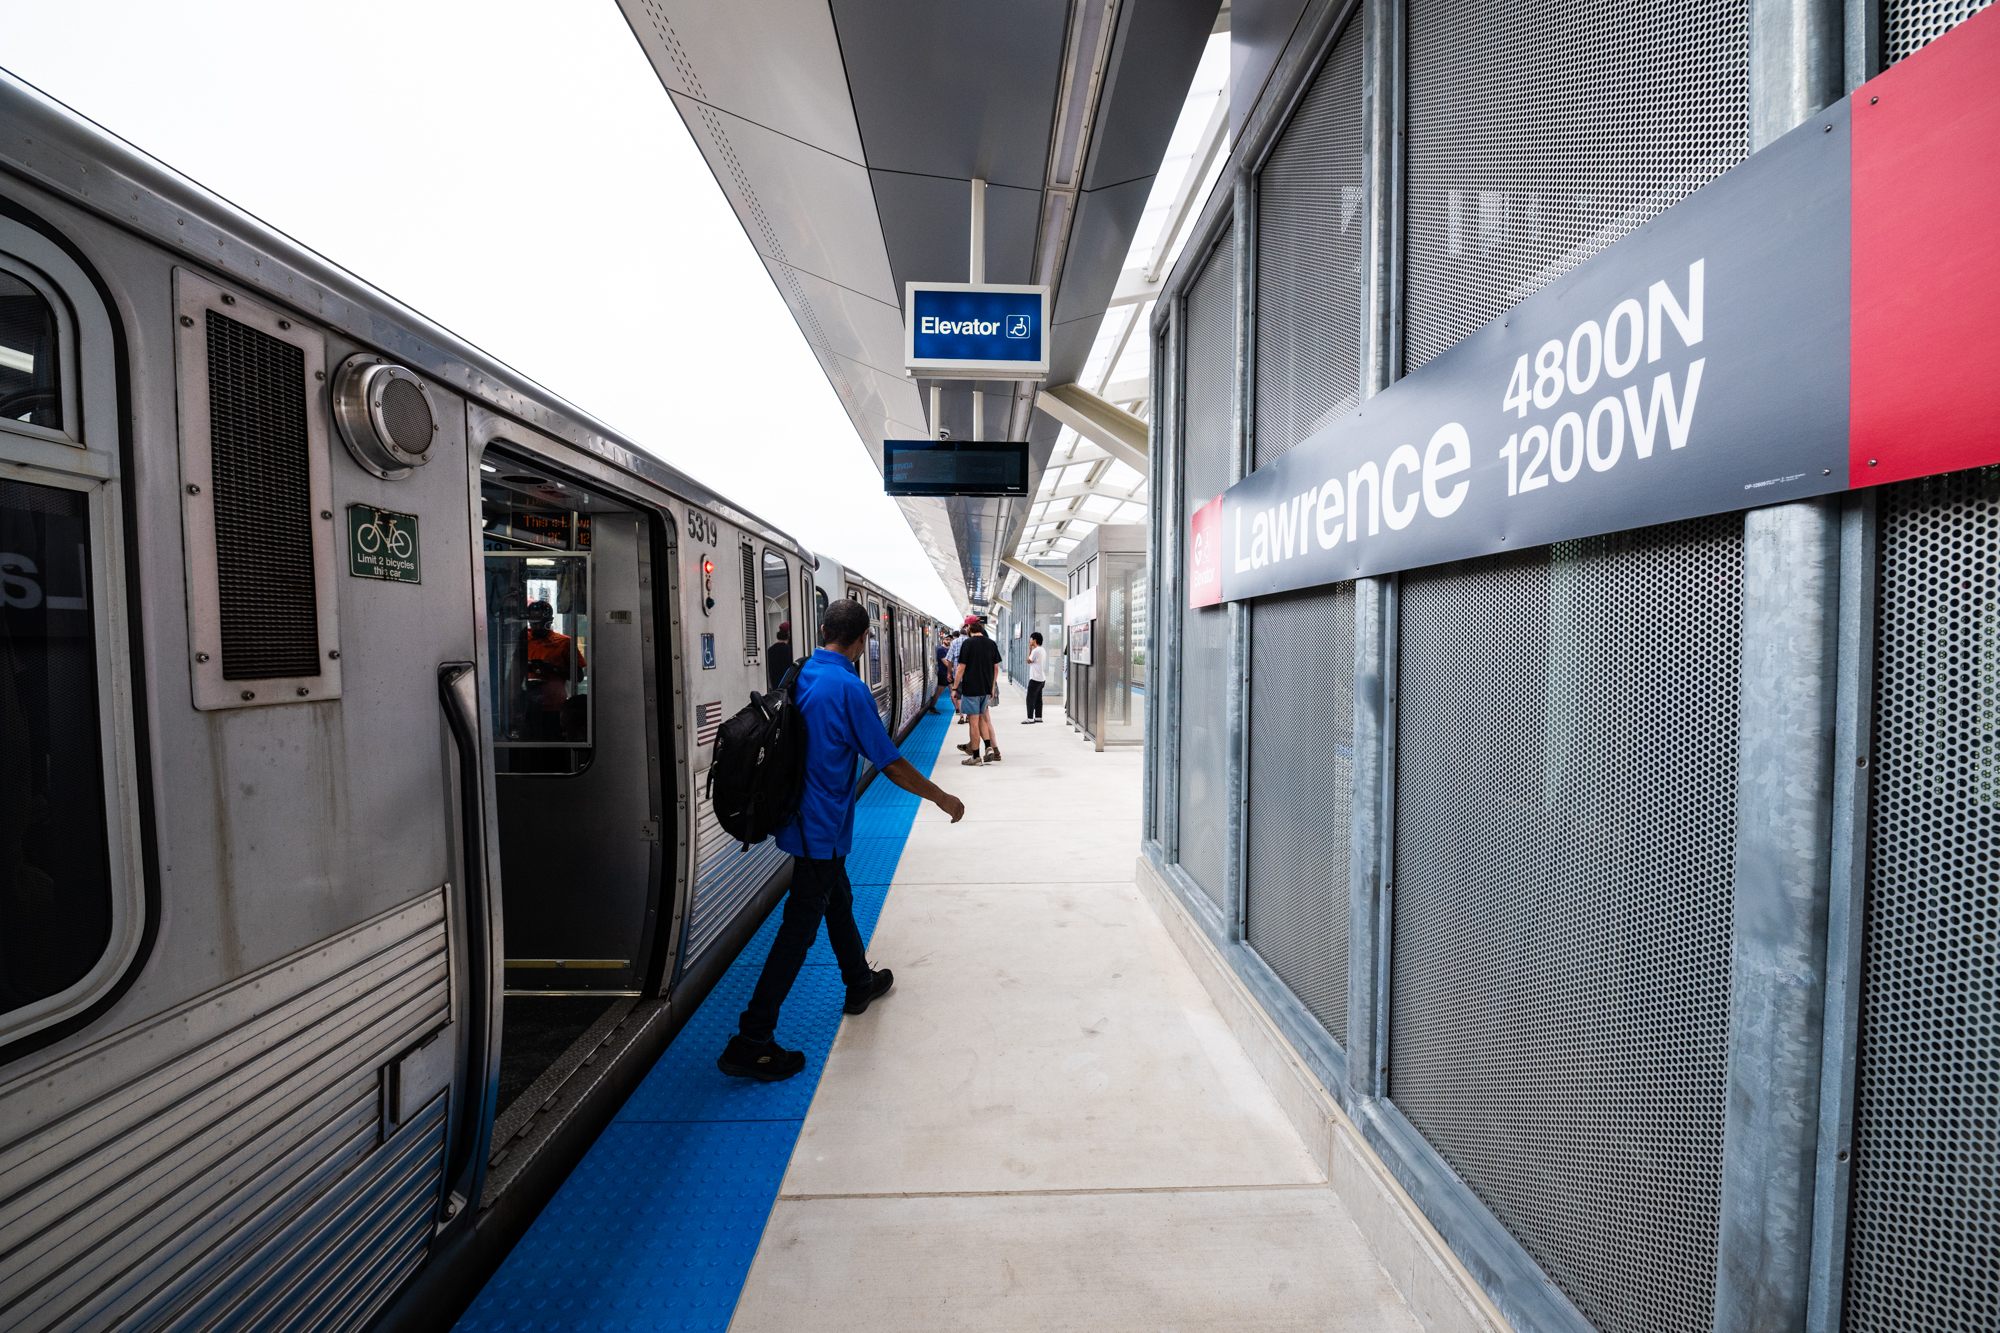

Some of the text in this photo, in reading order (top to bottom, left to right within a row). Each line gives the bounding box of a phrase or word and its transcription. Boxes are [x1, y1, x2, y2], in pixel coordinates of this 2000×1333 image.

[921, 316, 1001, 336] Elevator
[1503, 257, 1705, 419] 4800N
[1499, 357, 1706, 497] 1200W
[1234, 422, 1471, 575] Lawrence
[523, 515, 548, 528] This
[687, 508, 718, 548] 5319
[357, 553, 415, 570] Limit 2 bicycles
[373, 566, 402, 578] this car
[1193, 567, 1215, 588] Elevator
